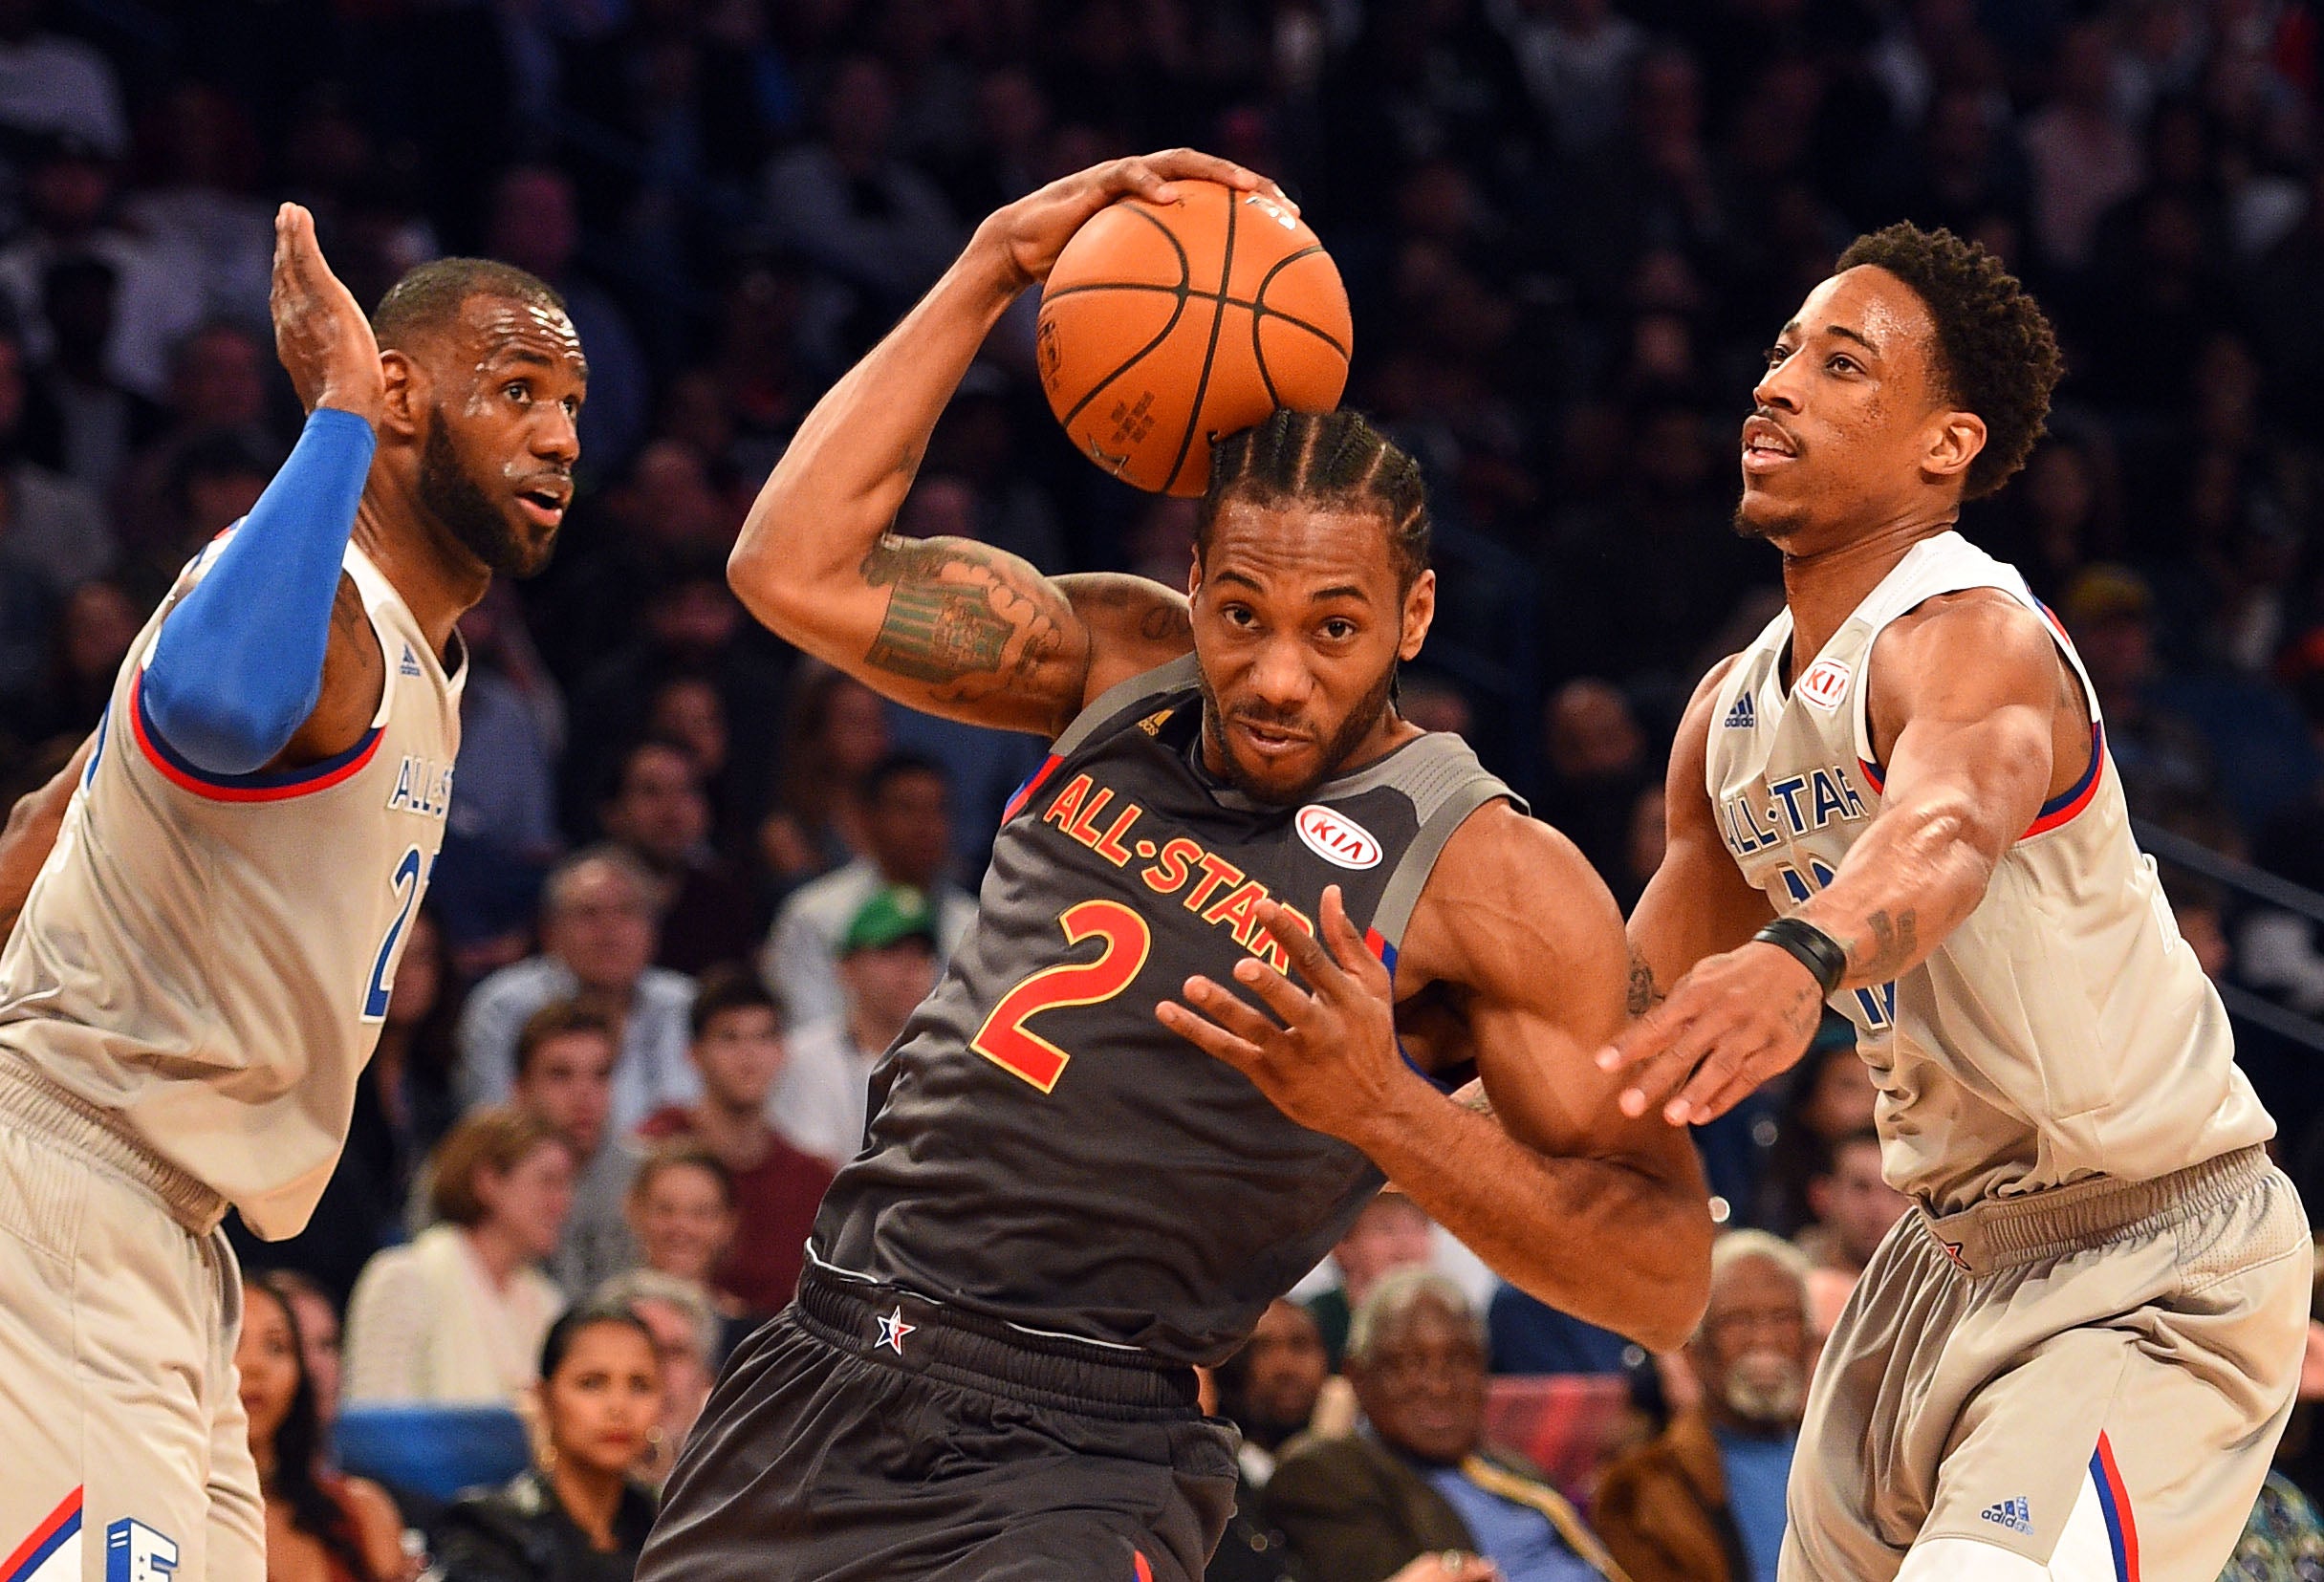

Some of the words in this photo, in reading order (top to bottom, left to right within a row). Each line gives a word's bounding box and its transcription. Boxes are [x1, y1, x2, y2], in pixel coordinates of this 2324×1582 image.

[1311, 817, 1363, 860] KIA
[359, 842, 440, 1024] 2
[969, 899, 1151, 1094] 2
